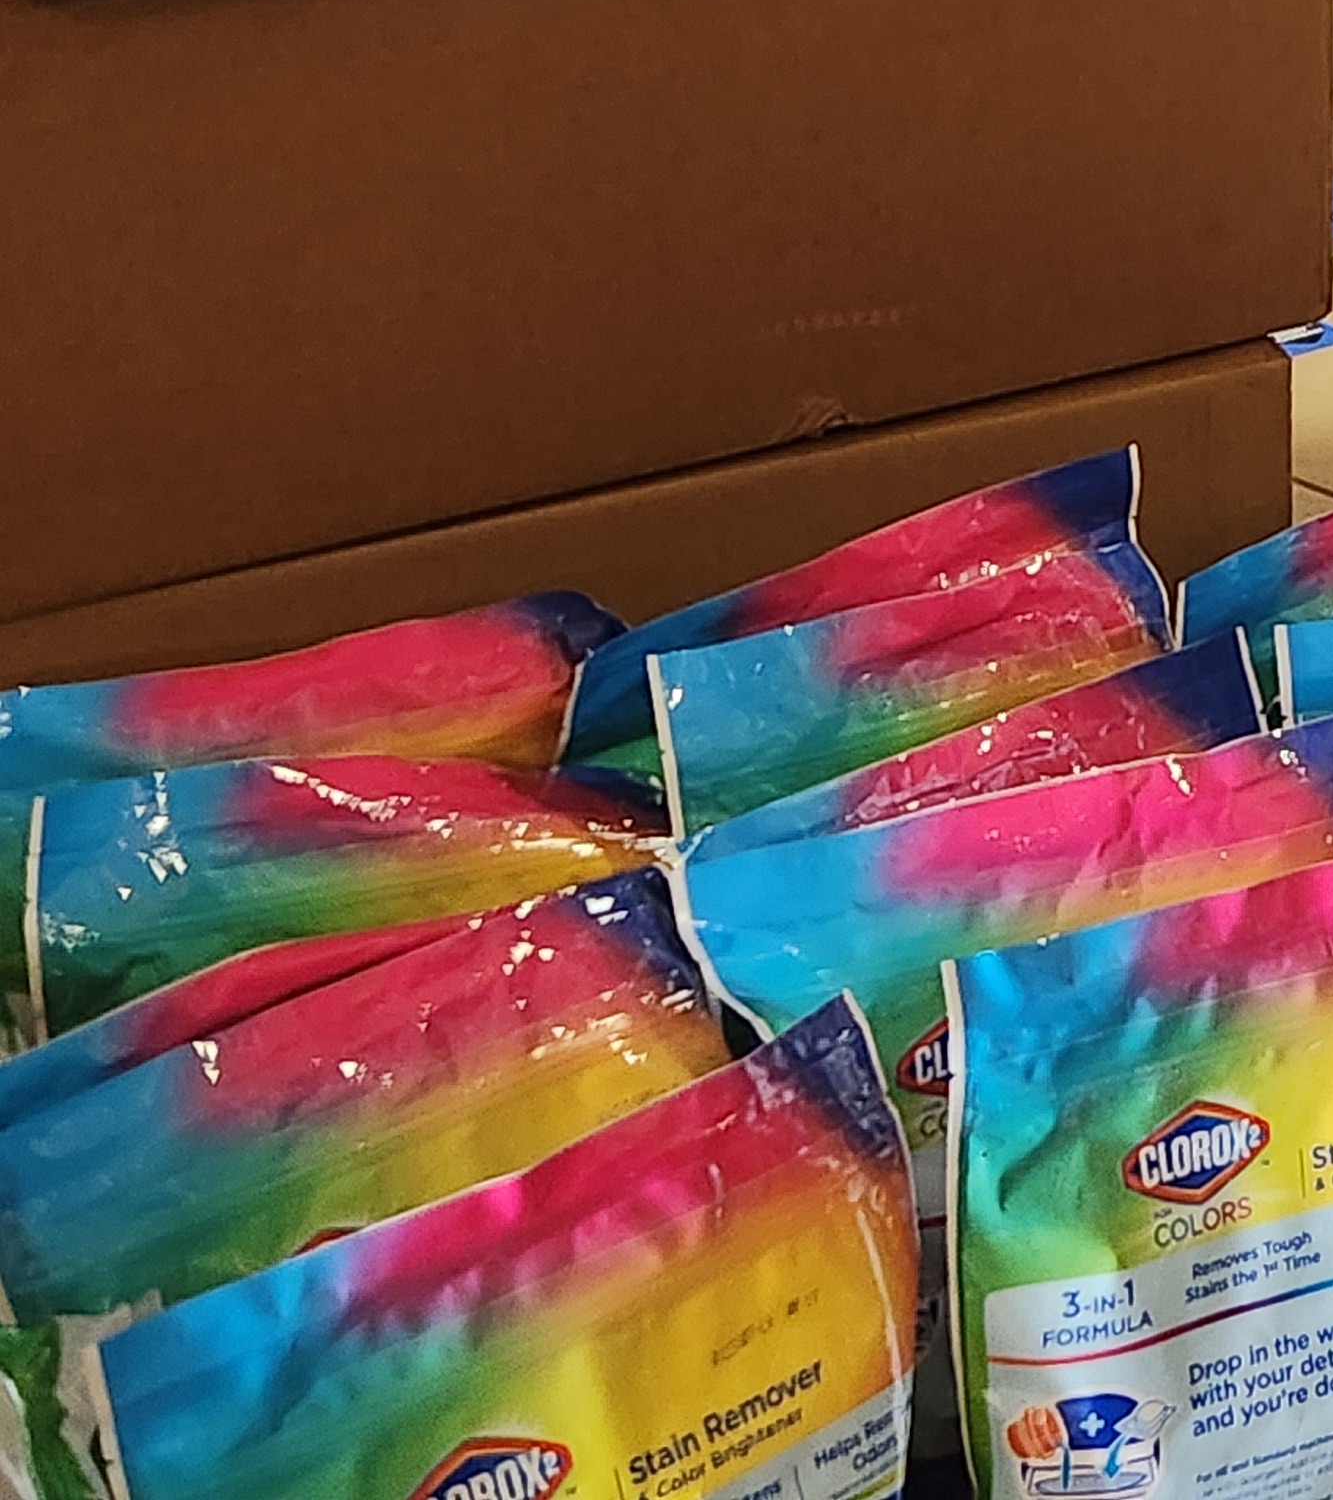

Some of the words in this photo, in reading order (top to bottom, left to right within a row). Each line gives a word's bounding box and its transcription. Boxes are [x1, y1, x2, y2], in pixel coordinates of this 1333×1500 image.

[1152, 1196, 1254, 1250] COLORS
[1183, 1275, 1230, 1303] Stains
[1231, 1269, 1259, 1289] the
[1281, 1250, 1323, 1274] Time
[1191, 1246, 1259, 1281] Removes
[1262, 1229, 1314, 1262] Tough
[1060, 1277, 1137, 1320] 3-IN-1
[1041, 1310, 1154, 1350] FORMULA
[1188, 1351, 1244, 1387] Drop
[1248, 1341, 1270, 1368] in
[1273, 1330, 1311, 1360] the
[1187, 1376, 1238, 1412] with
[1242, 1363, 1293, 1399] your
[1191, 1402, 1236, 1440] and
[1240, 1386, 1310, 1427] you're
[627, 1430, 702, 1486] Stain
[702, 1358, 824, 1445] Remover
[655, 1462, 706, 1500] Color
